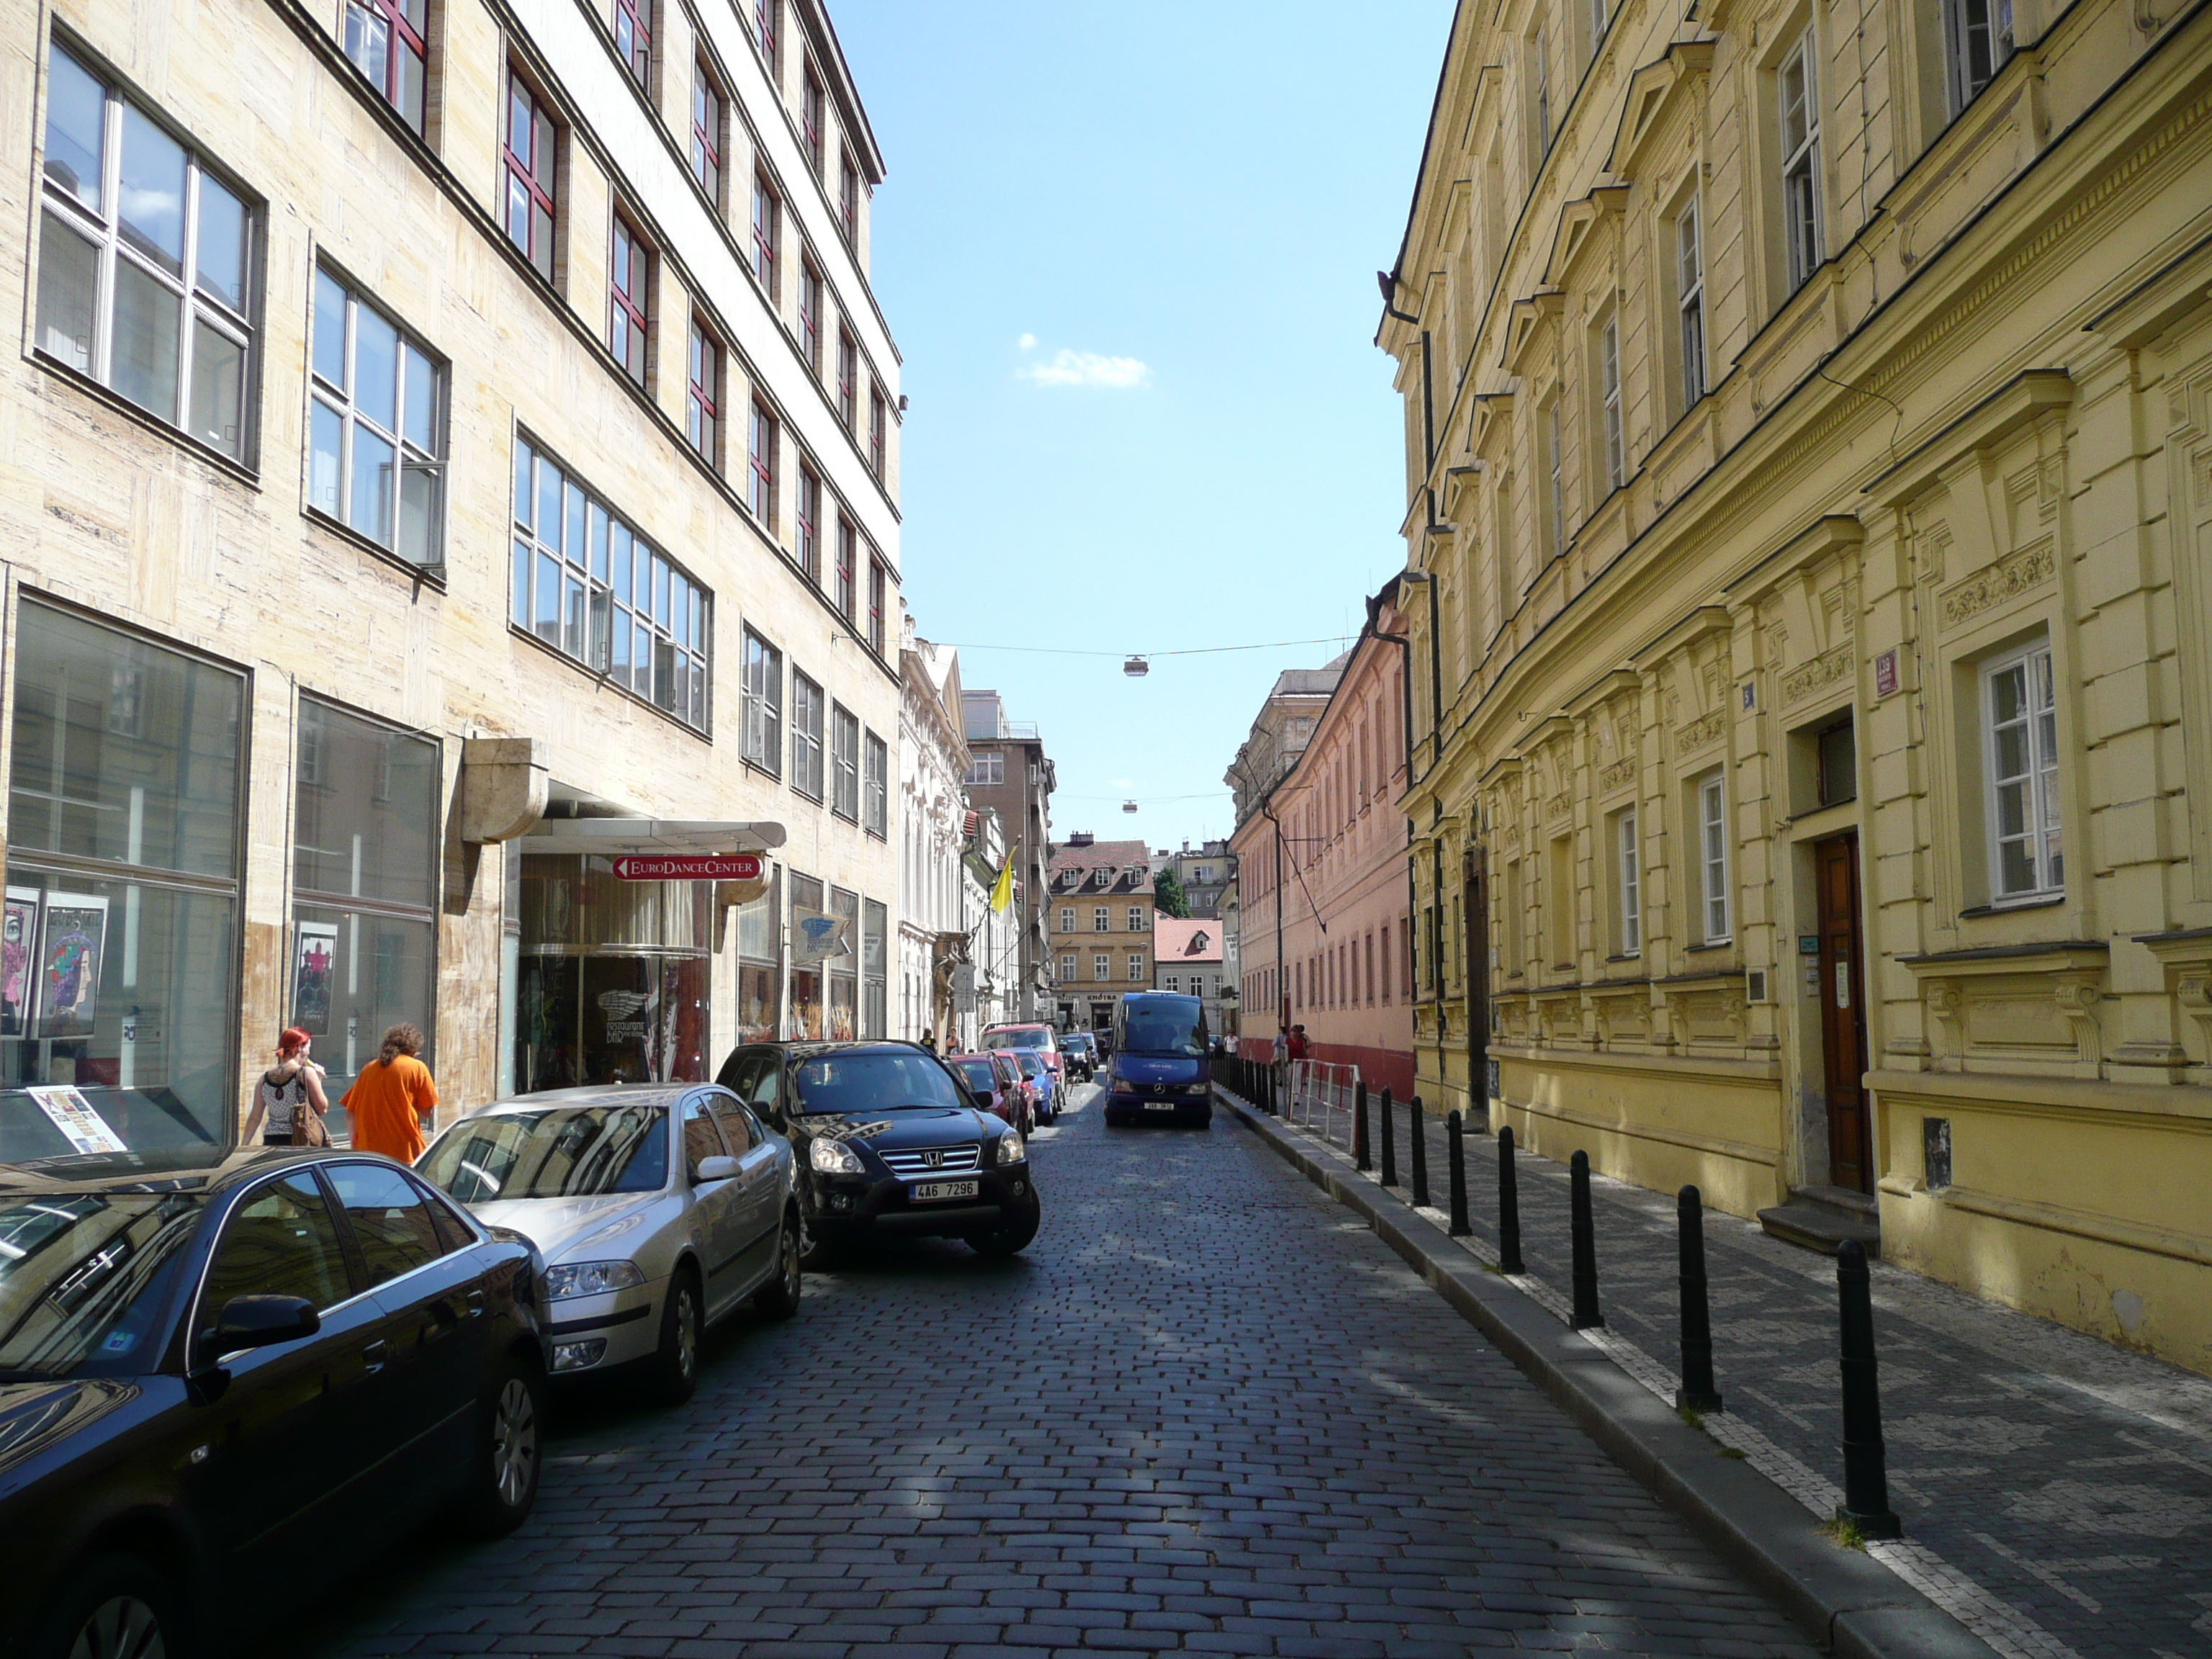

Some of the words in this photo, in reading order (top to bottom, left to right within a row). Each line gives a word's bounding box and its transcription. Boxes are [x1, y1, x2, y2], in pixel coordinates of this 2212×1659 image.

[1879, 657, 1890, 675] 139
[1744, 690, 1749, 704] 5
[607, 1022, 644, 1030] restaurant
[918, 1185, 938, 1198] 4A6
[946, 1182, 973, 1196] 7296
